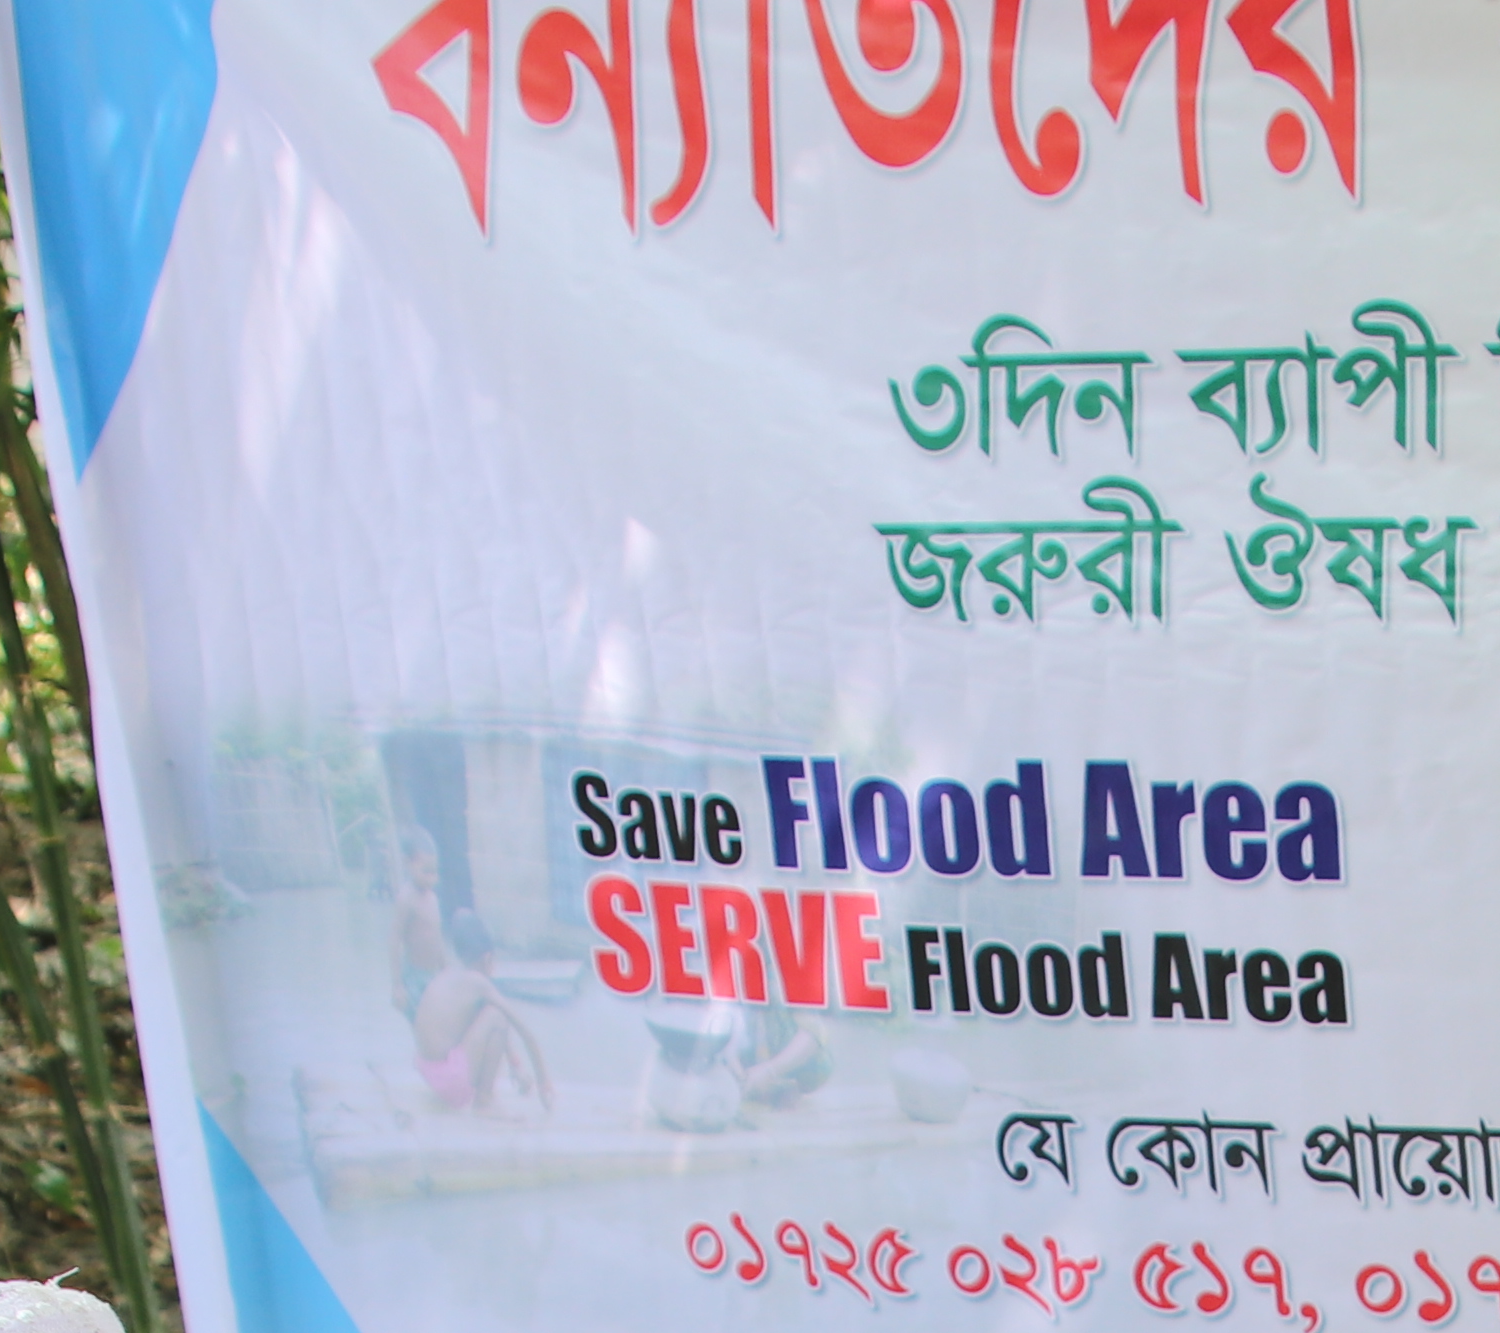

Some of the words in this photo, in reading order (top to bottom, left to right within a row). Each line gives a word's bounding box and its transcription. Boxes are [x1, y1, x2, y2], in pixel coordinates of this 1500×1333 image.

[887, 313, 1154, 457] ৩দিন
[1174, 299, 1461, 456] ব্যাপী
[873, 475, 1186, 623] জরুরী
[1223, 472, 1482, 624] ঔষধ
[572, 770, 744, 867] Save
[761, 754, 1054, 877] Flood
[1080, 759, 1343, 883] Area
[586, 875, 890, 1011] SERVE
[905, 925, 1129, 1018] Flood
[1151, 932, 1348, 1024] Area
[997, 1112, 1077, 1187] যে
[1106, 1109, 1277, 1195] কোন
[686, 1212, 915, 1303] ০১৭২৫
[947, 1233, 1098, 1317] ০২৮
[1134, 1241, 1320, 1333] ৫১৭,
